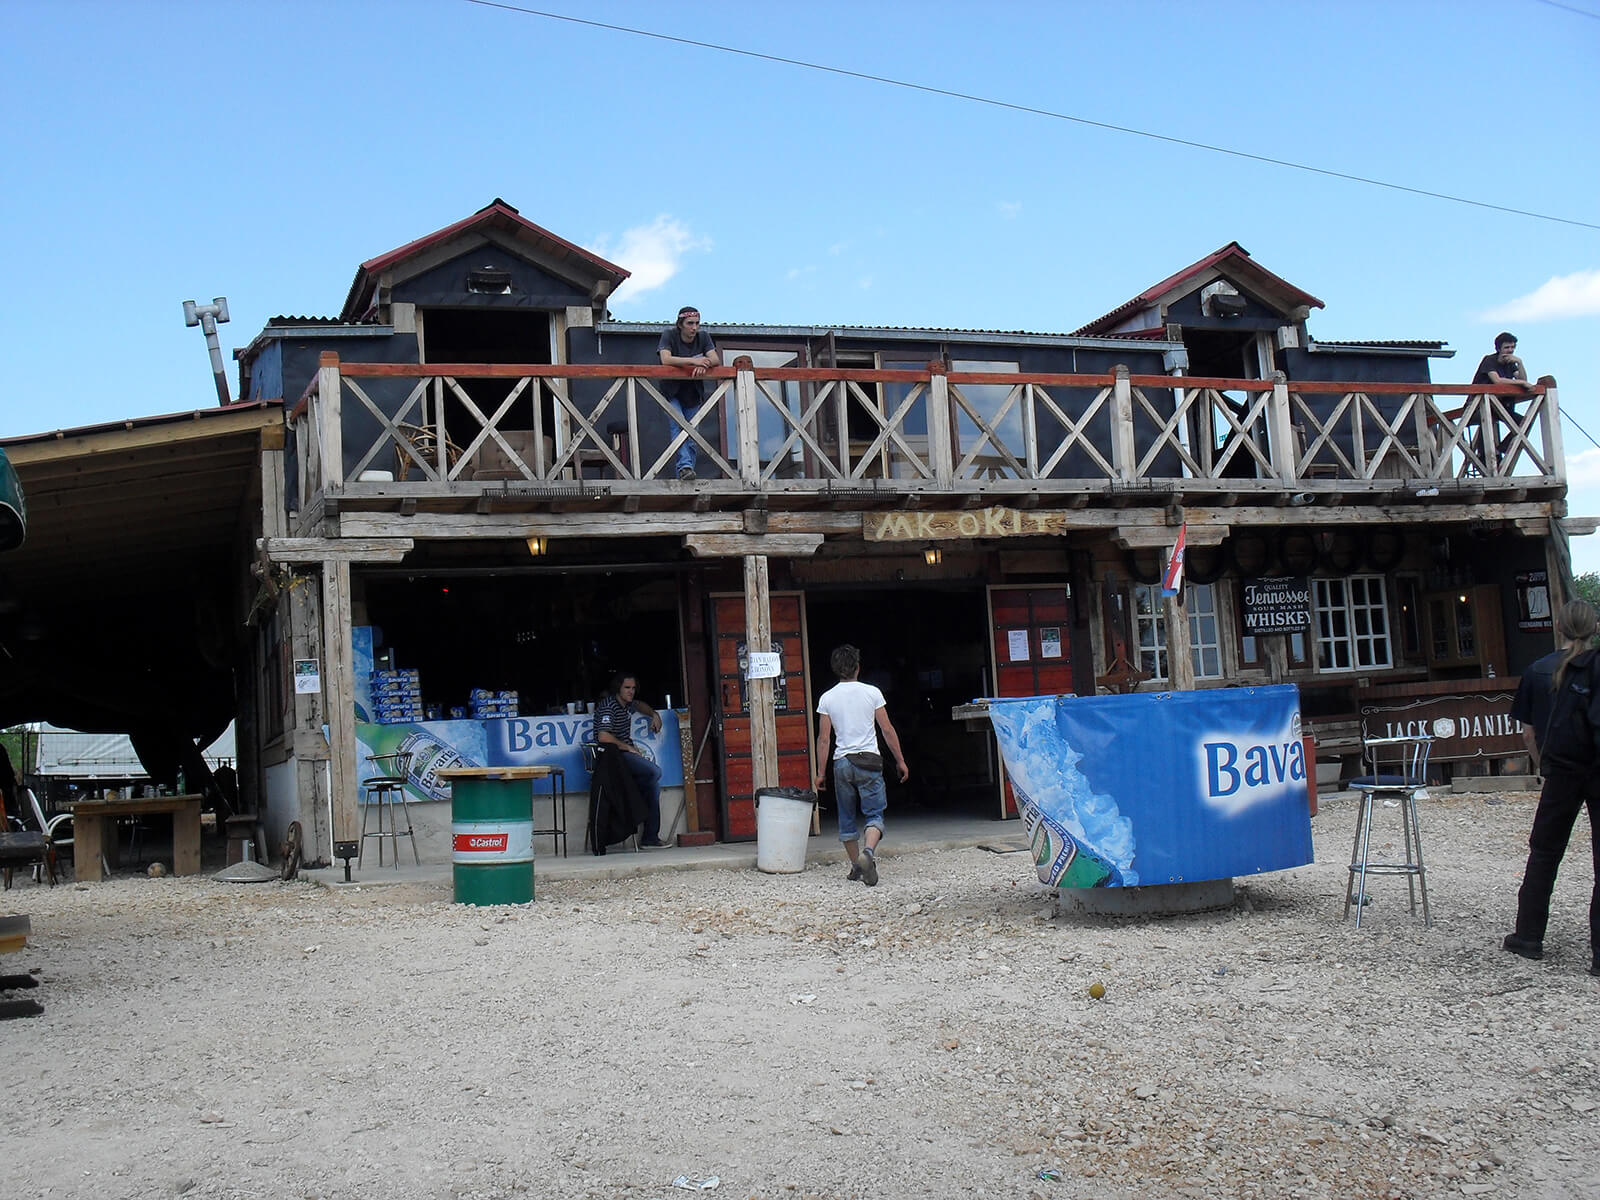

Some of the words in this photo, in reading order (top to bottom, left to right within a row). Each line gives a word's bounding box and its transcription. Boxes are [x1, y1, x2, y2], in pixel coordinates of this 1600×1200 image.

[876, 511, 936, 540] MK
[1244, 585, 1310, 606] Tennessee
[1243, 610, 1311, 628] WHISKEY
[1386, 719, 1430, 739] JACK
[1203, 740, 1306, 798] Bava
[476, 838, 503, 848] Castrol
